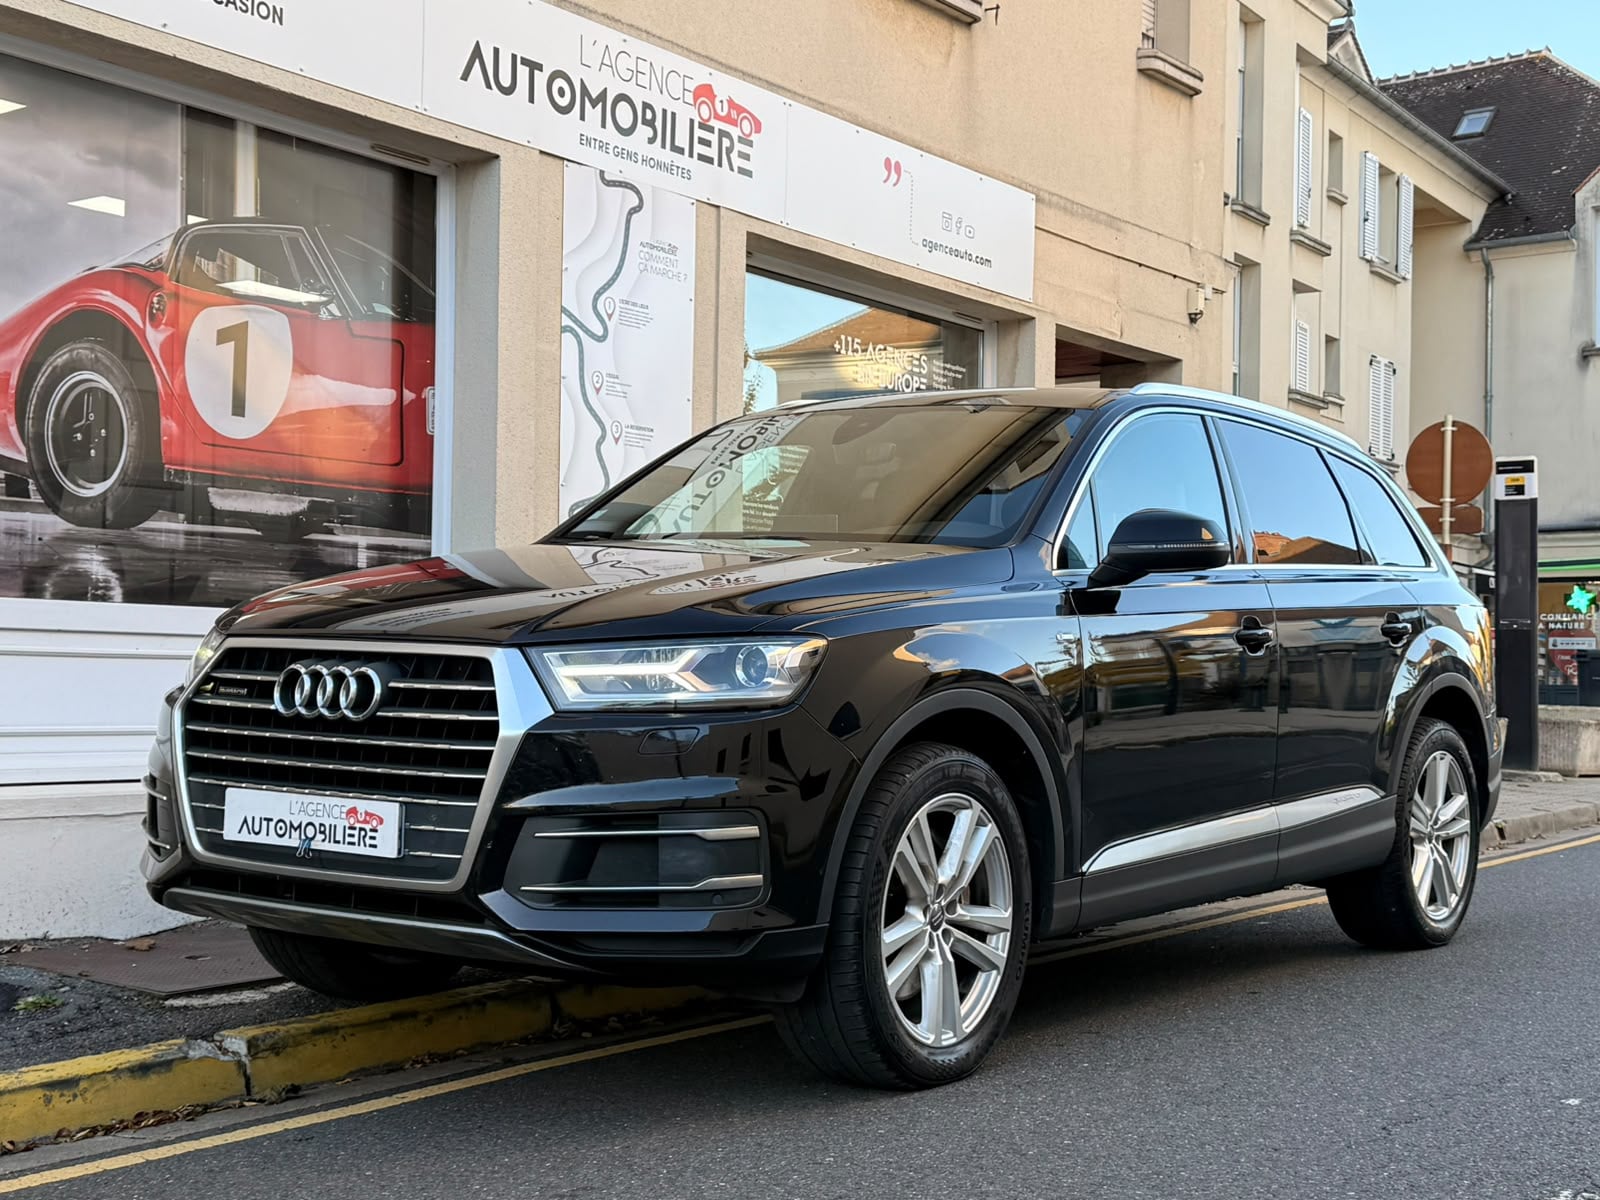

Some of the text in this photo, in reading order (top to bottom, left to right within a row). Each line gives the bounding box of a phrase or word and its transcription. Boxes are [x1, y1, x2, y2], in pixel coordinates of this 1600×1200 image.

[213, 0, 283, 26] ASION
[579, 34, 695, 106] L'AGENCE
[579, 133, 692, 181] ENTRE GENS HONNÊTES
[921, 237, 992, 269] agenceauto.com
[216, 320, 249, 418] 1
[834, 334, 862, 356] +115
[865, 341, 928, 375] AGENCES
[595, 374, 600, 385] 2
[615, 424, 620, 434] 3
[289, 799, 347, 821] L'AGENCE
[238, 815, 378, 849] AUTOMOBILIERE
